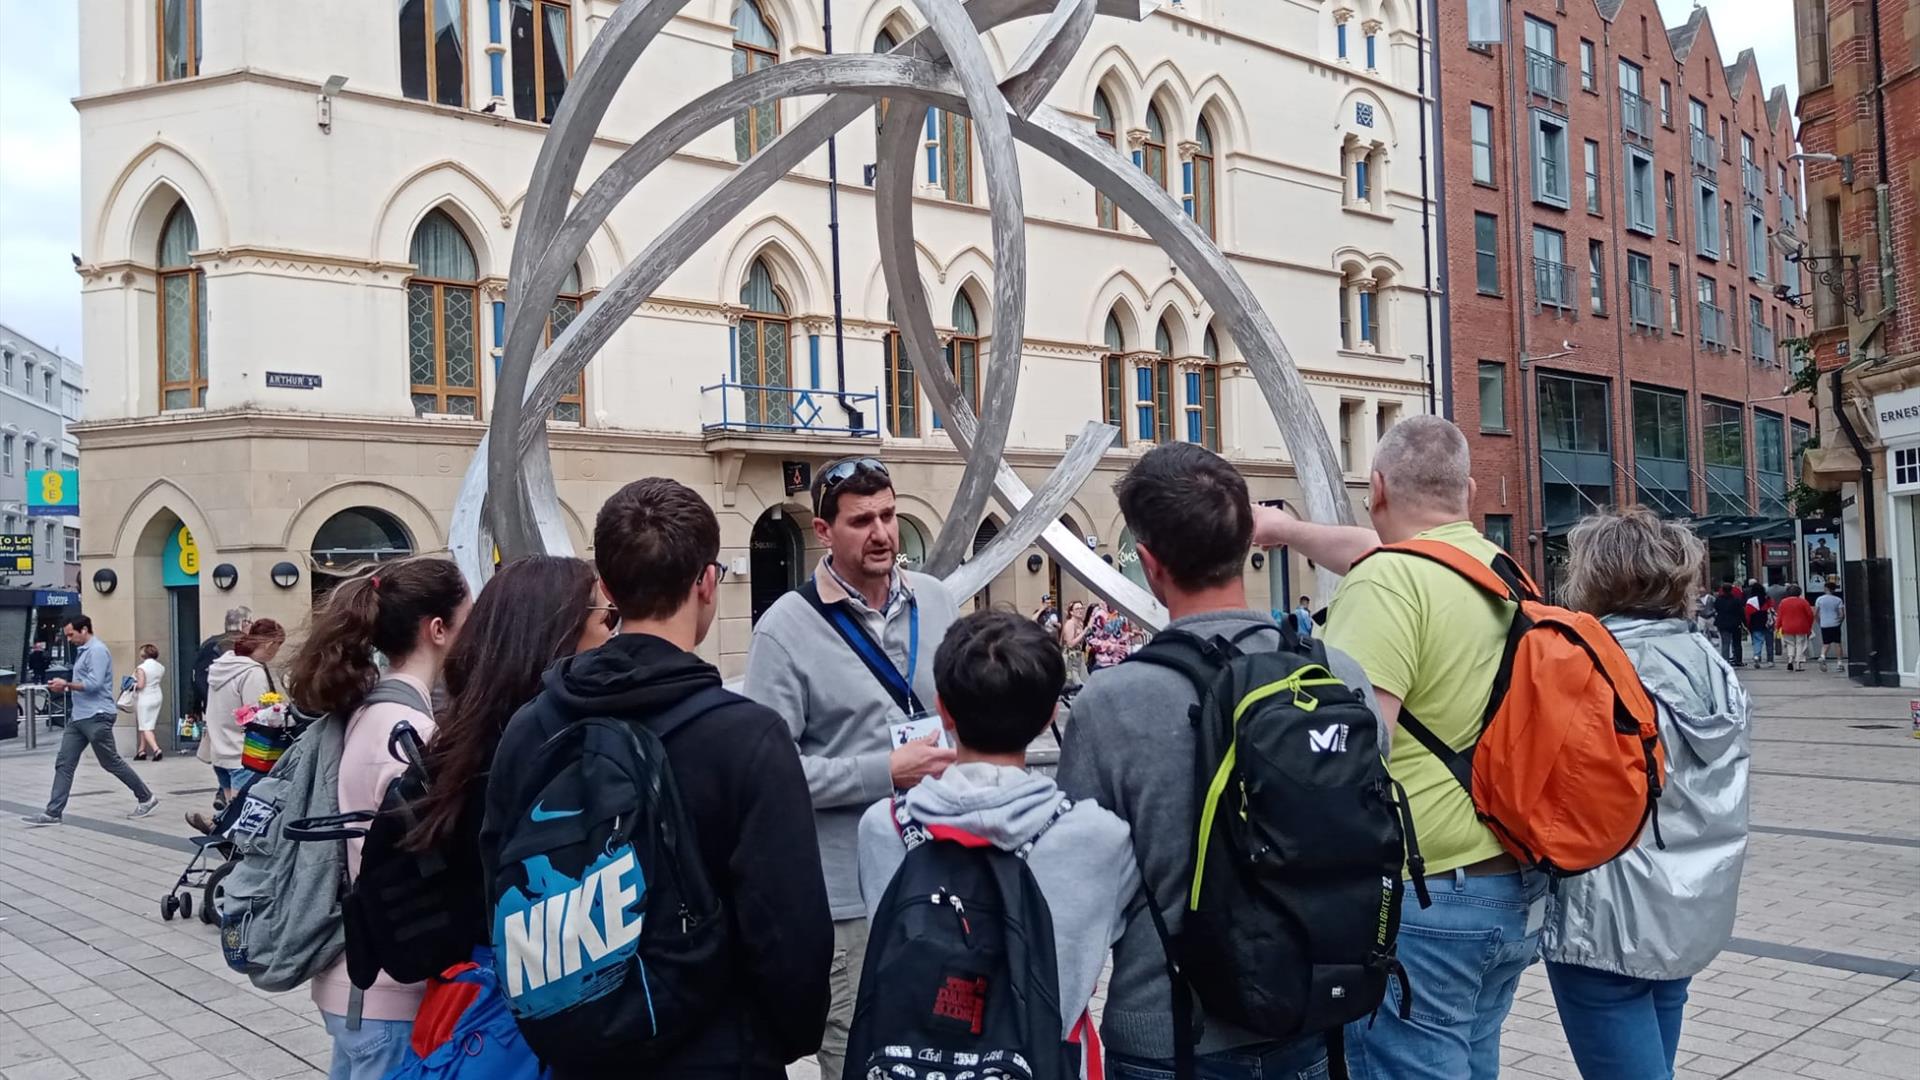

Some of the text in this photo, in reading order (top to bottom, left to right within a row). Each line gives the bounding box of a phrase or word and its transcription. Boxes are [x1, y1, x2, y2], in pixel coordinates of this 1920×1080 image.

[269, 375, 303, 385] ARTHUR
[1880, 405, 1920, 422] ERNES
[14, 536, 32, 544] Let
[505, 851, 642, 998] NIKE
